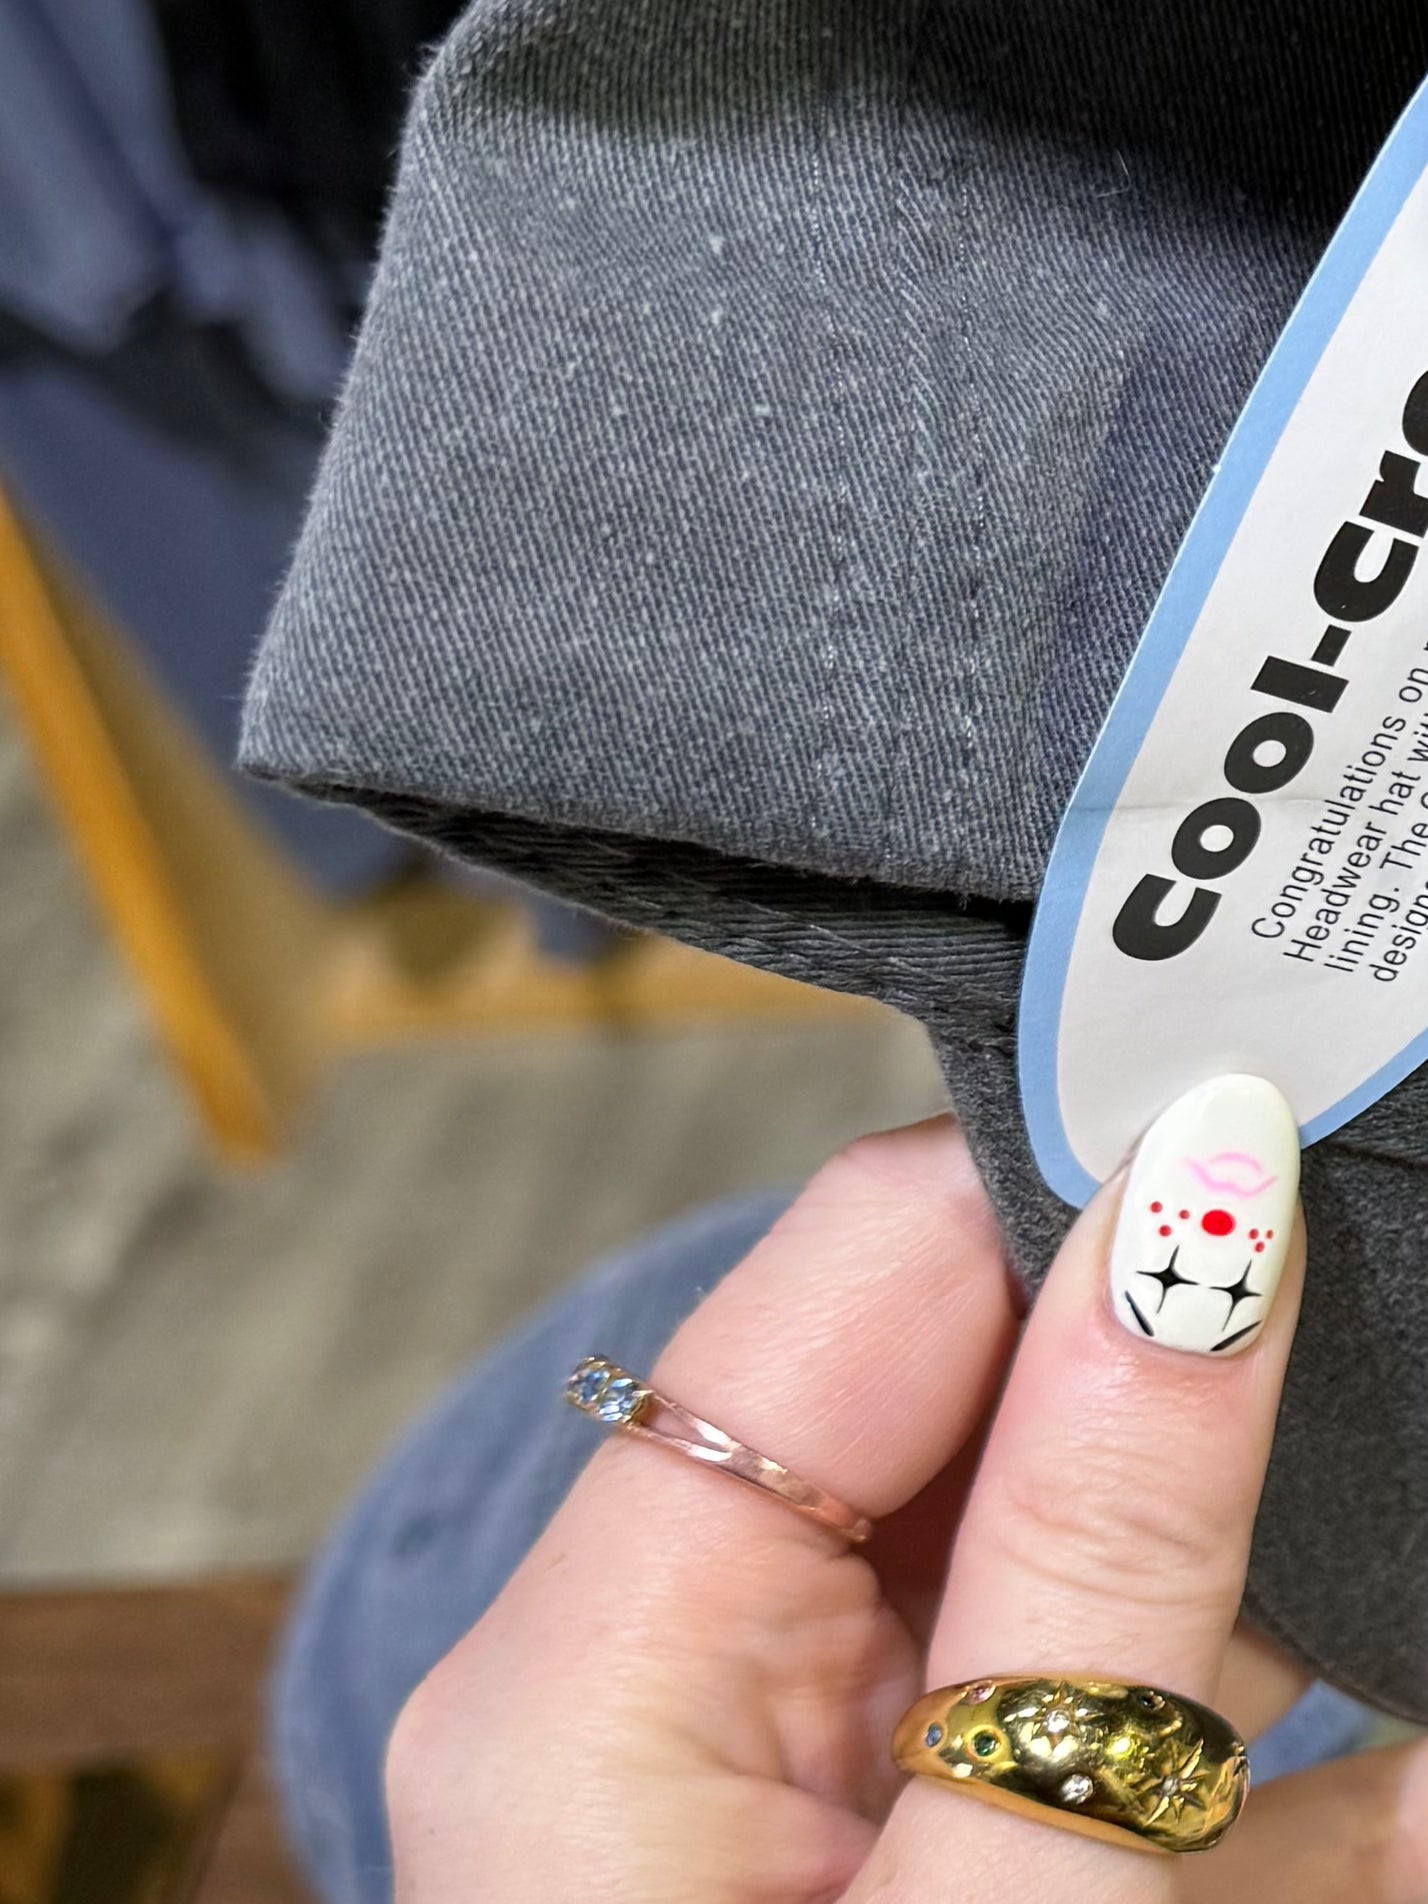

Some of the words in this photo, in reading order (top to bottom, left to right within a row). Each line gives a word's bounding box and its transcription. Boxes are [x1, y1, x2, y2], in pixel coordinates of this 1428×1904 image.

[1250, 715, 1407, 939] Congratulations
[1281, 820, 1387, 962] Headwear
[1366, 770, 1421, 816] hat
[1322, 886, 1400, 973] lining.
